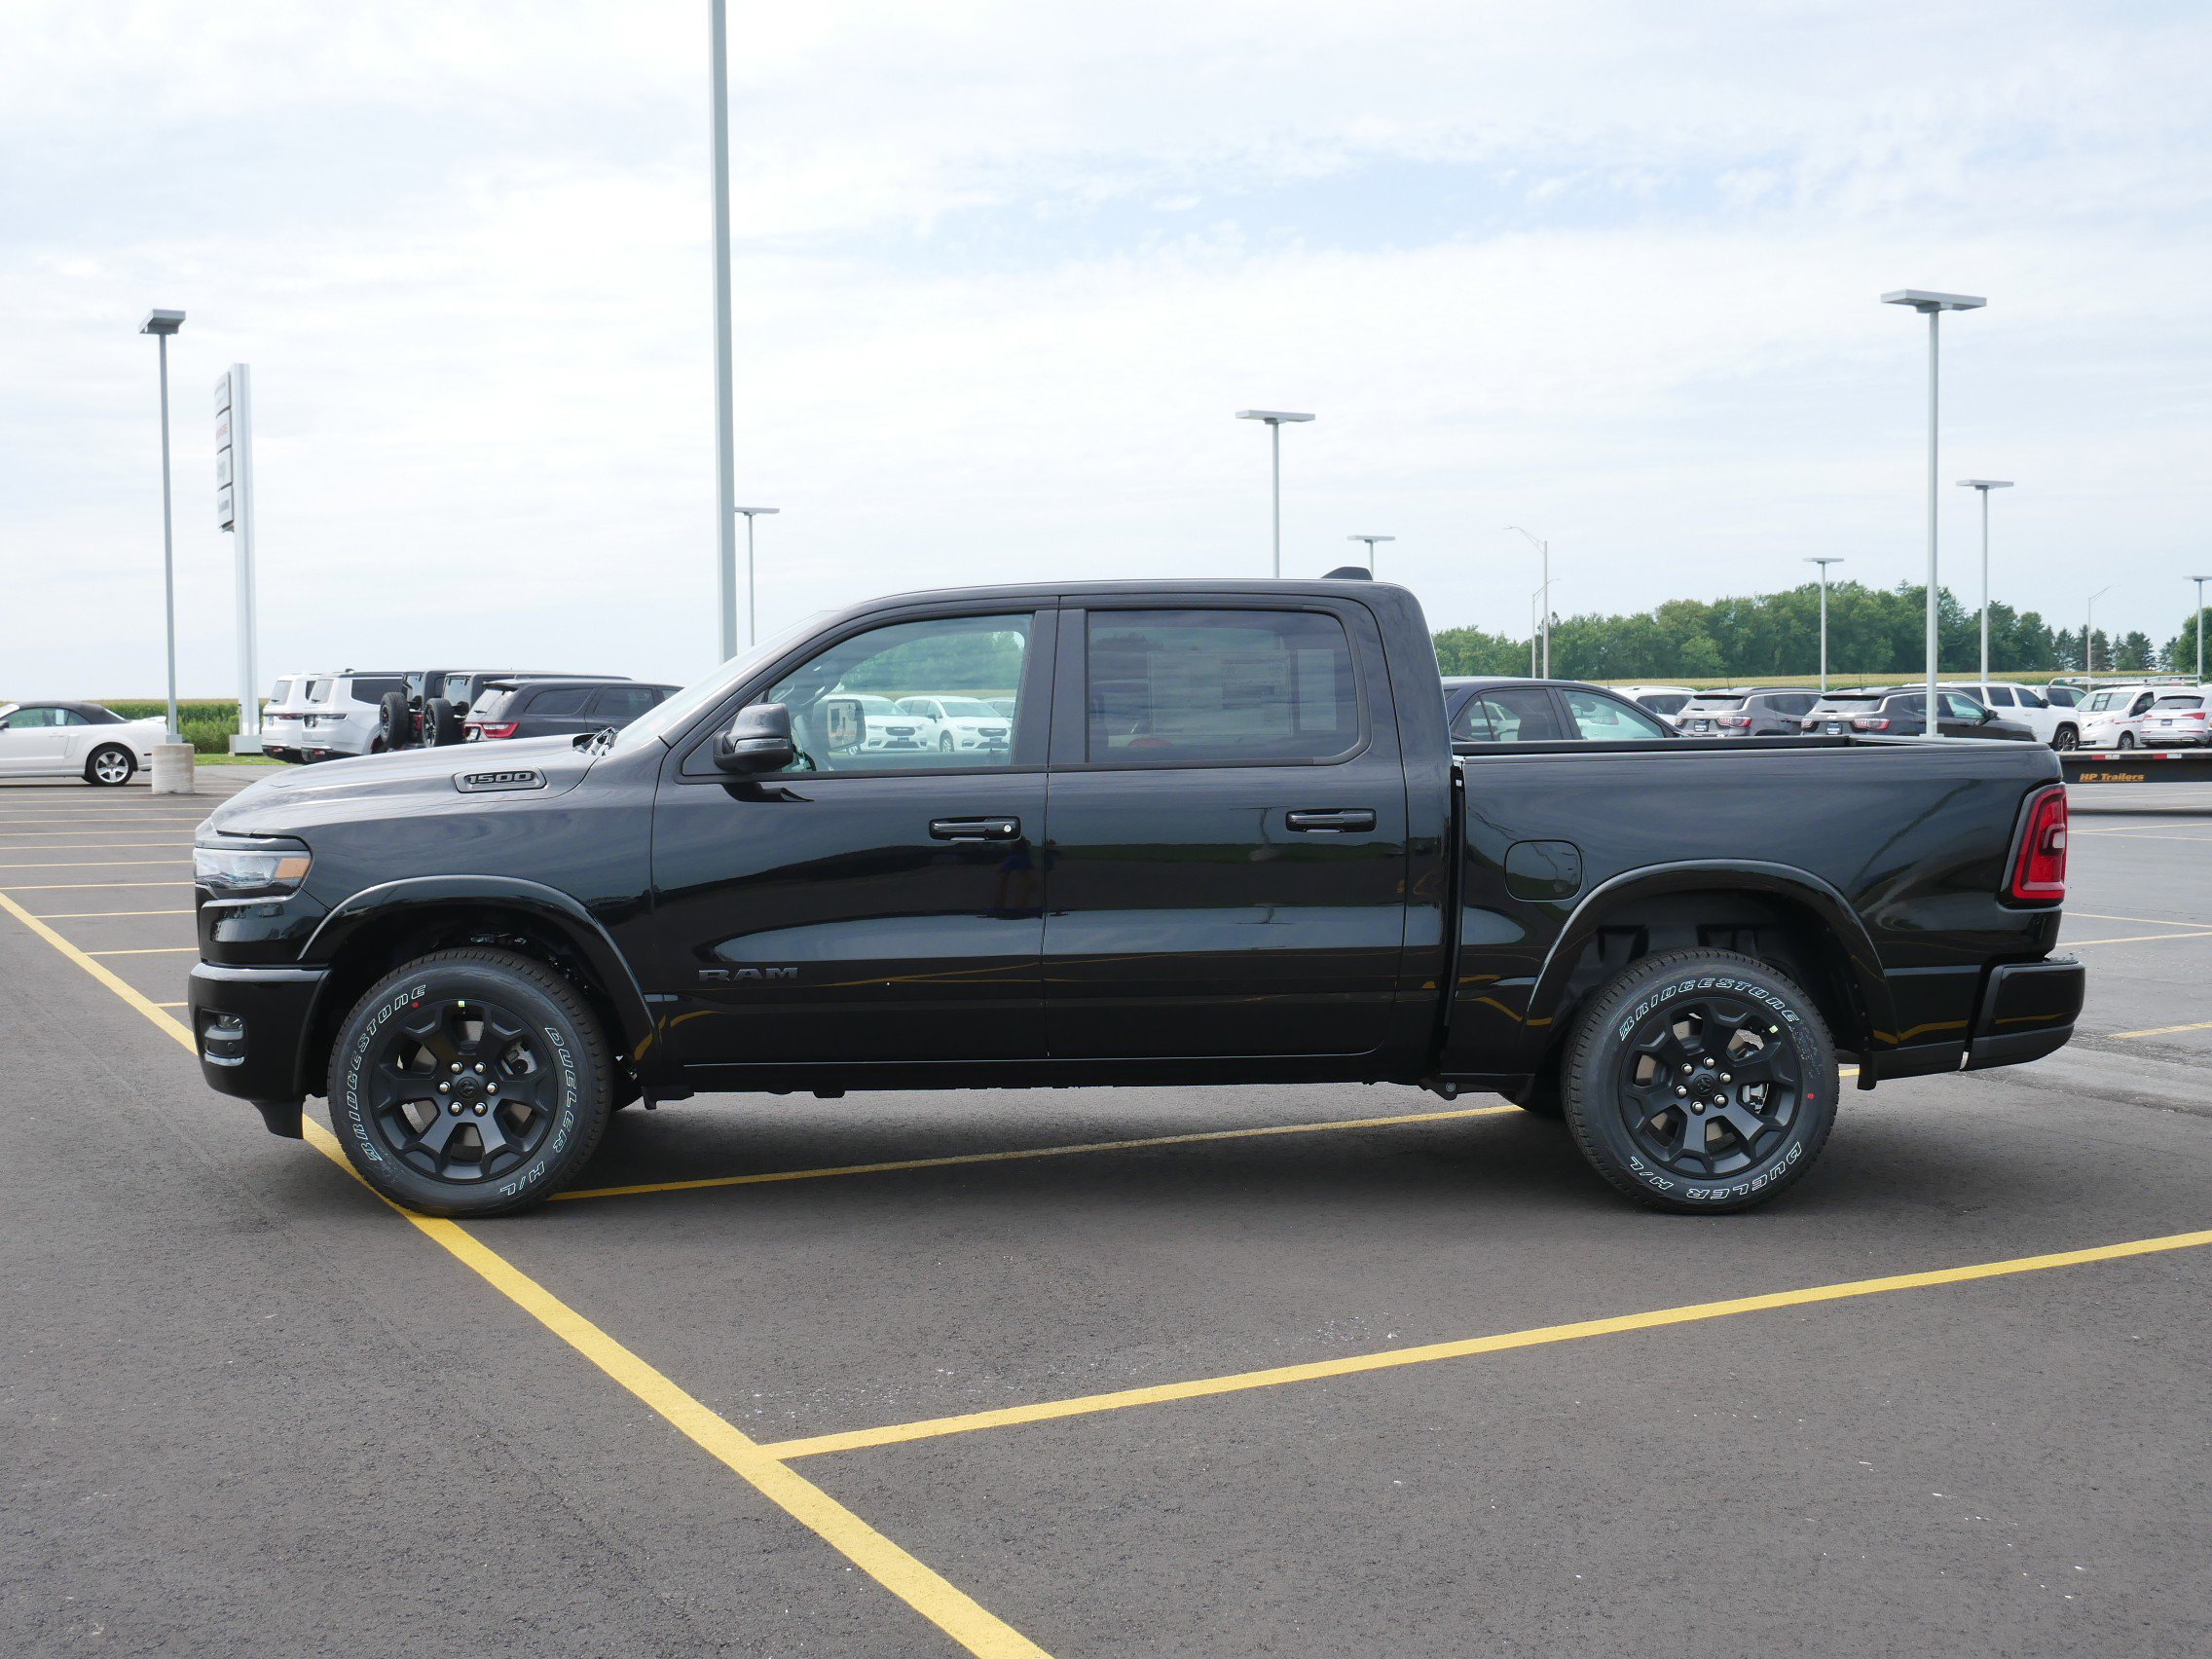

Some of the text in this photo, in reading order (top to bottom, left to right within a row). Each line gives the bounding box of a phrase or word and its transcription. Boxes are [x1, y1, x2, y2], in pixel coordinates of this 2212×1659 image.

[468, 772, 532, 784] 1500
[2079, 773, 2145, 782] HP Trailers
[698, 967, 798, 981] RAM
[1620, 977, 1800, 1041] BRIDGESTONE
[347, 984, 426, 1161] BRIDGESTONE
[499, 1027, 576, 1196] DUELER H/L
[1629, 1141, 1802, 1200] DUELER H/L
